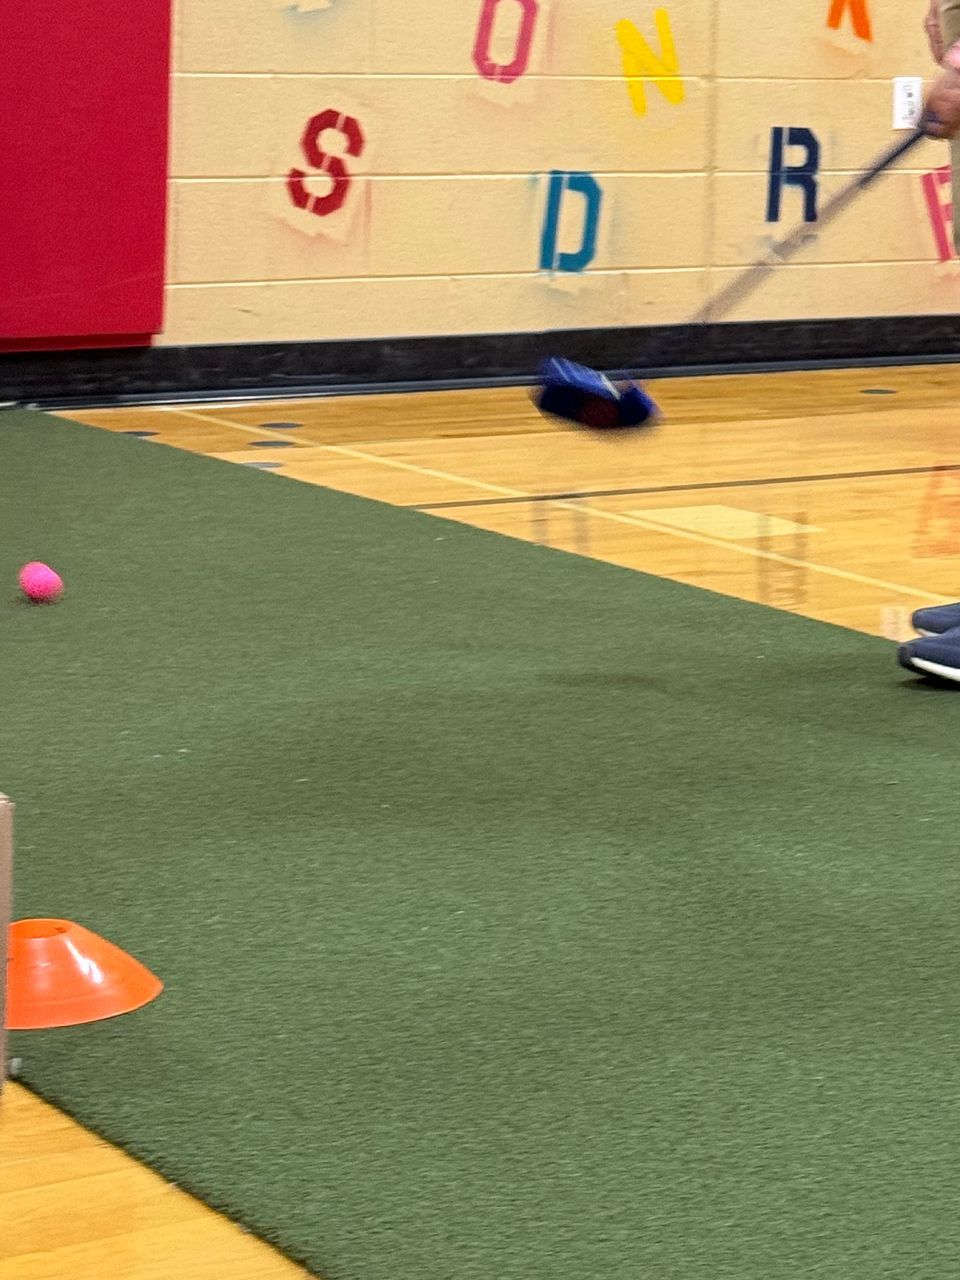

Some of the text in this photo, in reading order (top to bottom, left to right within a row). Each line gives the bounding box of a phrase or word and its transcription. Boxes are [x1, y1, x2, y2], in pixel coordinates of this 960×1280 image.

[615, 7, 686, 118] N
[284, 108, 366, 217] S
[765, 126, 821, 222] R
[539, 169, 604, 274] D
